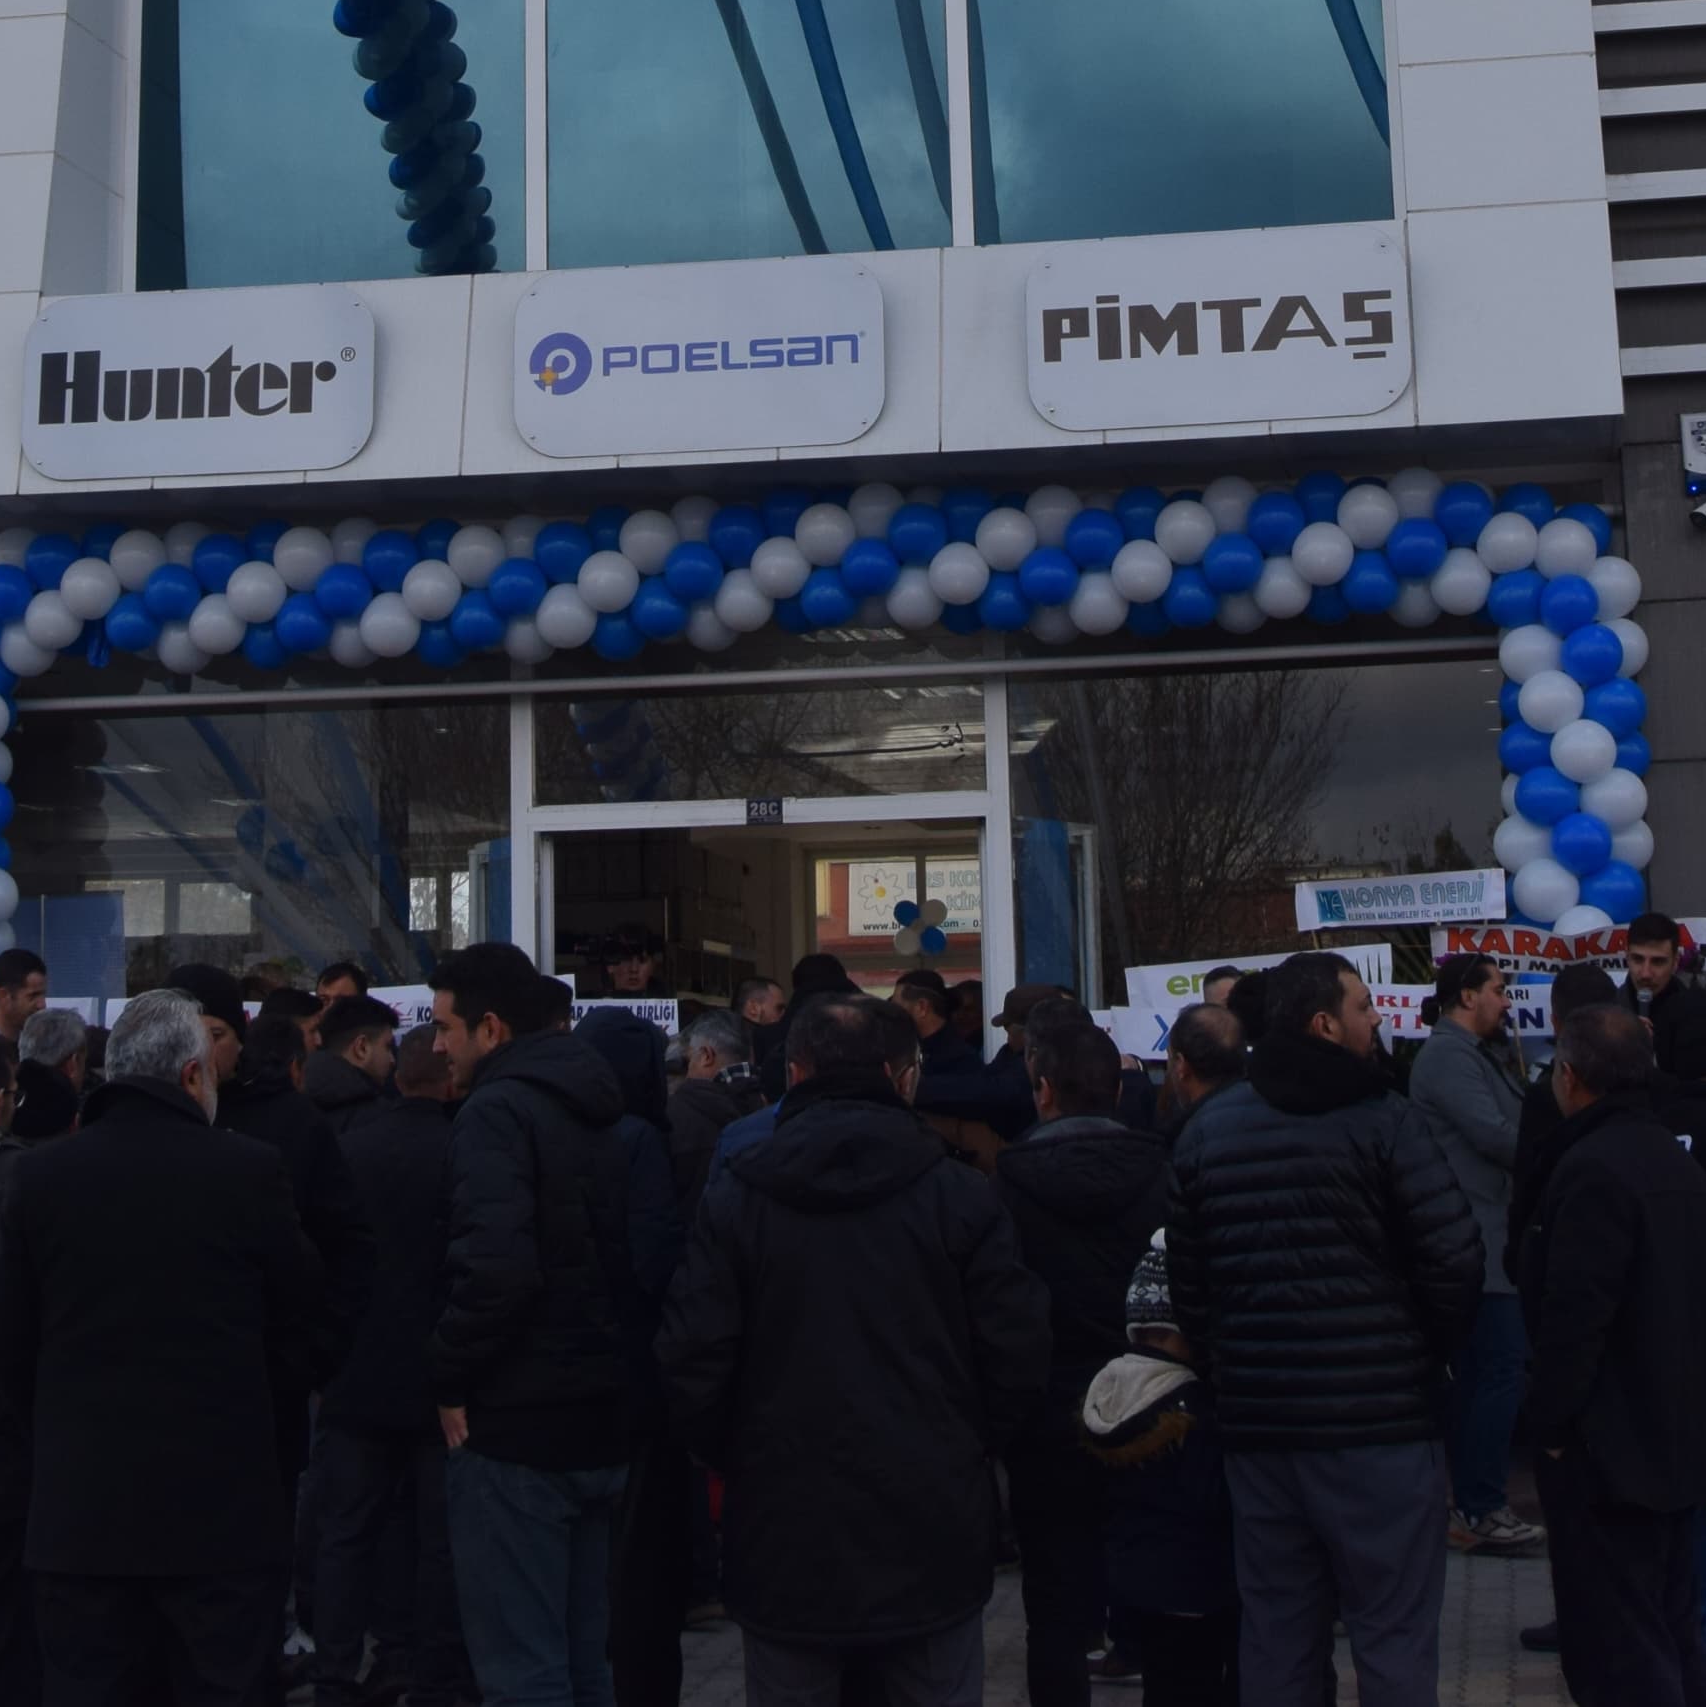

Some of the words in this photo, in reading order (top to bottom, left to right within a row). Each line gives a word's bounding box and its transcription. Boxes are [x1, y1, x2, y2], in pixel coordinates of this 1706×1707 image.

[1043, 290, 1394, 362] PİMTAŞ
[39, 345, 337, 425] Hunter
[749, 801, 779, 816] 28C
[1447, 923, 1695, 963] KARAKAA
